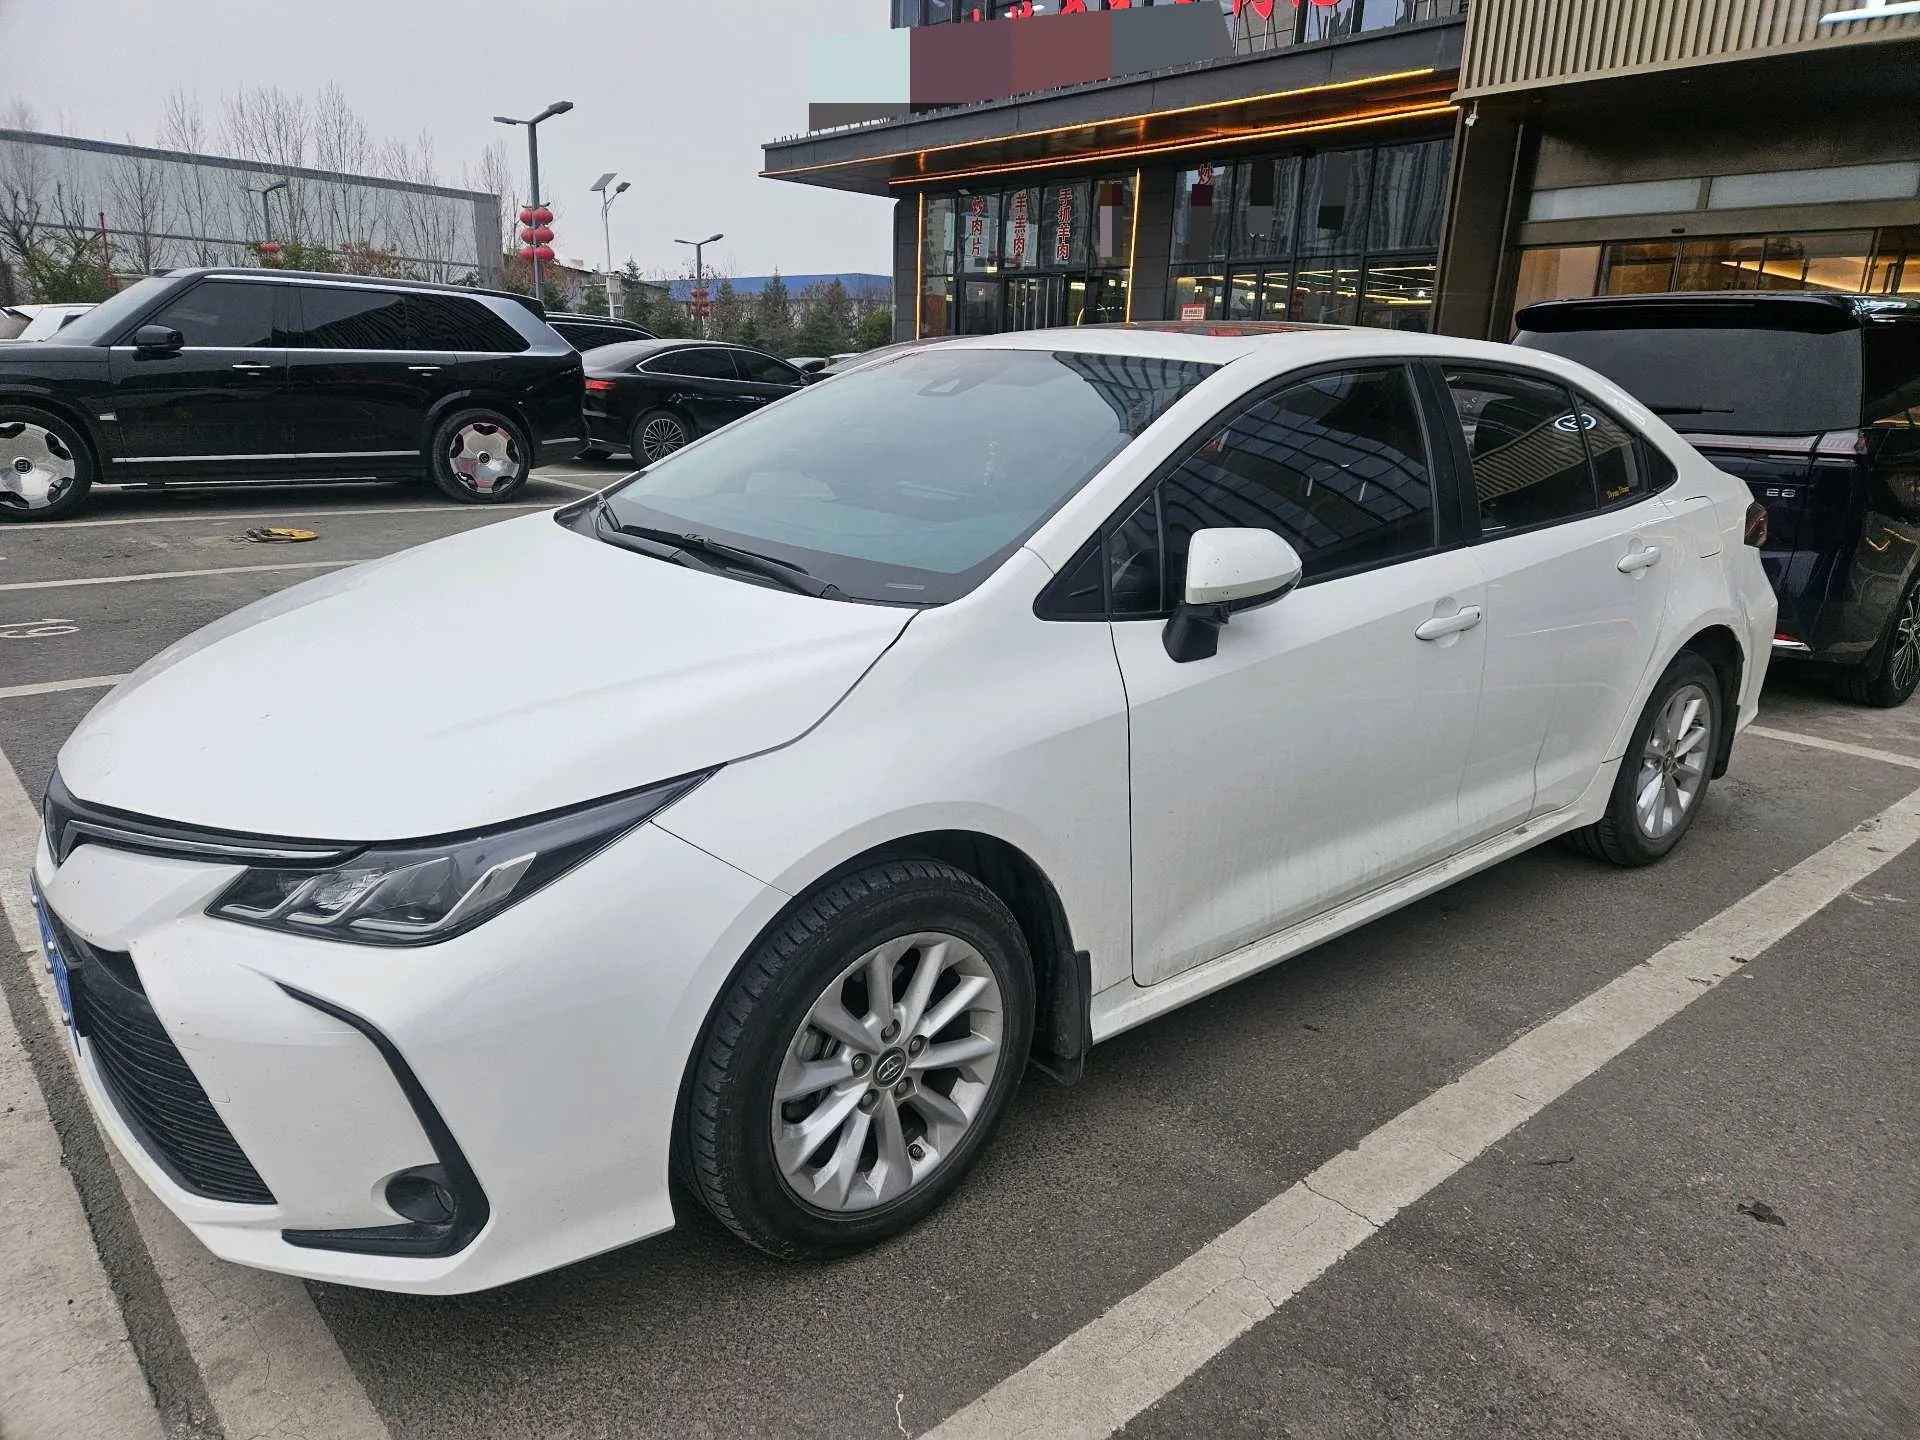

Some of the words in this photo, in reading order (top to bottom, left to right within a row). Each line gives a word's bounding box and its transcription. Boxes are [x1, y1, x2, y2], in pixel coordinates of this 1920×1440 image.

[1013, 192, 1027, 255] 羊羔肉
[1057, 188, 1073, 260] 手抓羊肉
